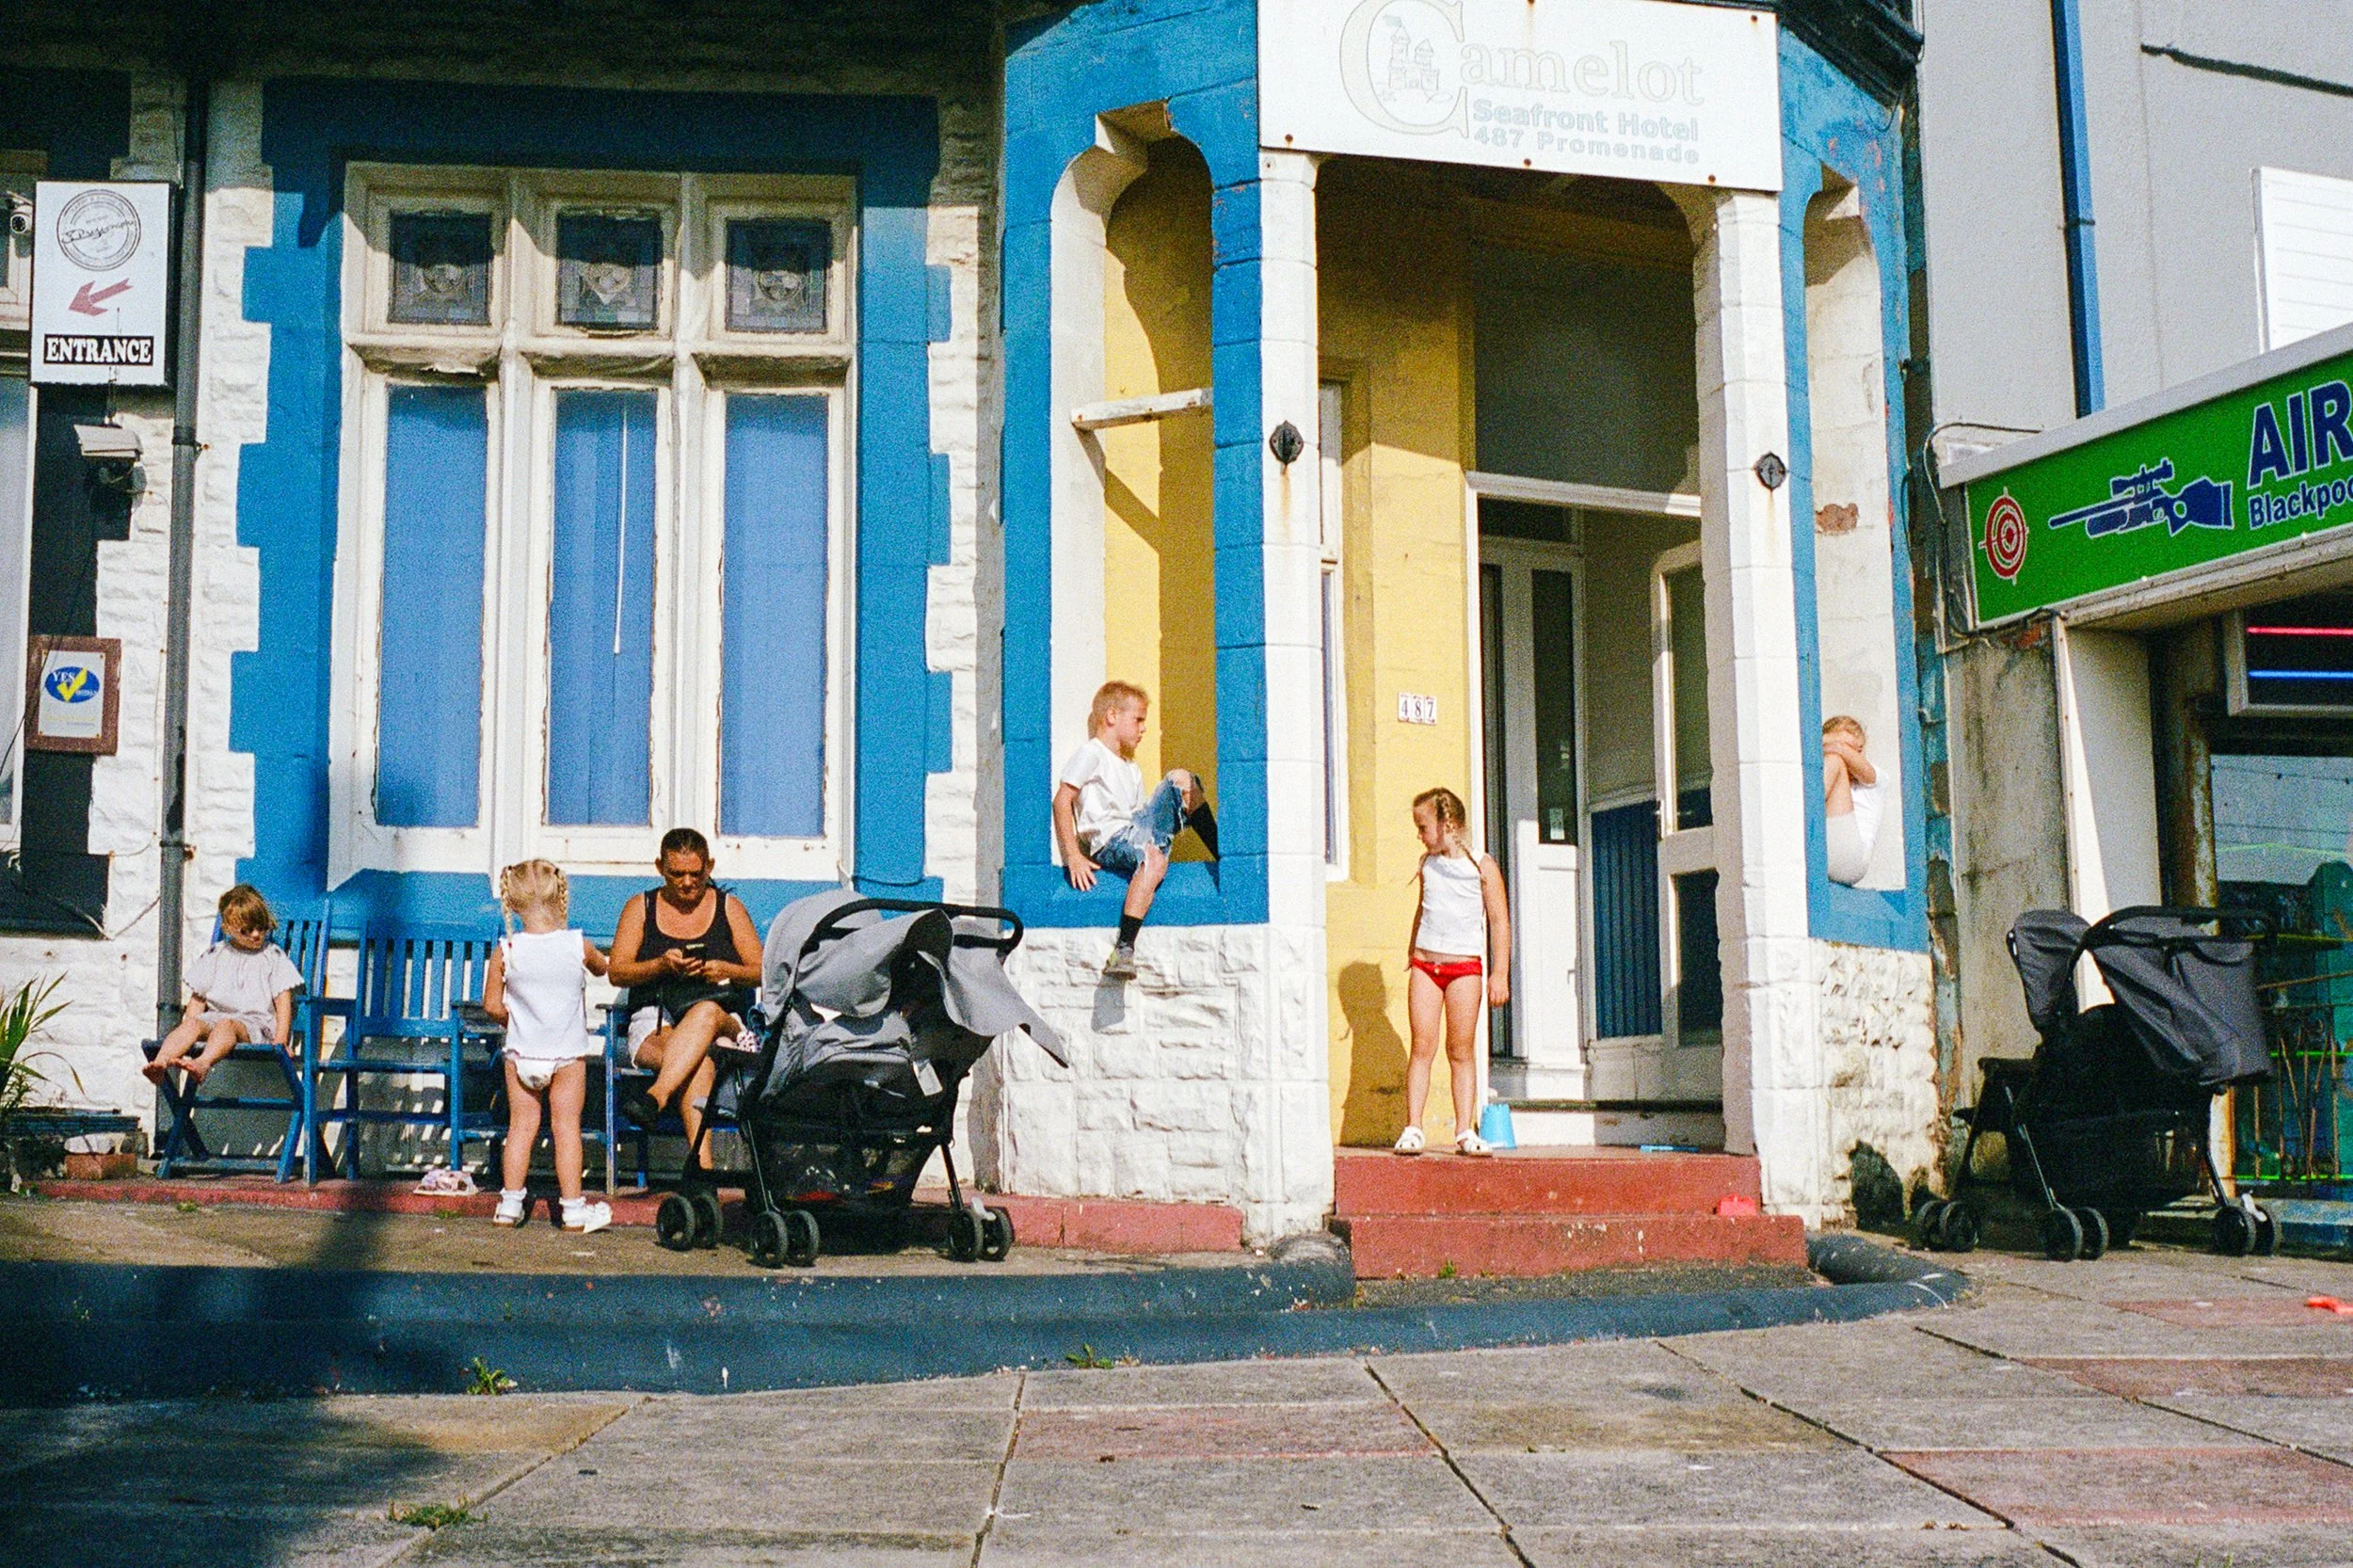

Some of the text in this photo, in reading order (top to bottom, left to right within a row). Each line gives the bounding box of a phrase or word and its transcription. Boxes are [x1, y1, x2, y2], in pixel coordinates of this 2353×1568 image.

[1339, 0, 1704, 138] Camelot
[1473, 98, 1699, 142] Seafront Hotel
[1474, 125, 1700, 165] 487 Promenade
[45, 337, 152, 363] ENTRANCE
[2248, 380, 2353, 489] AIR
[1401, 700, 1433, 717] 487
